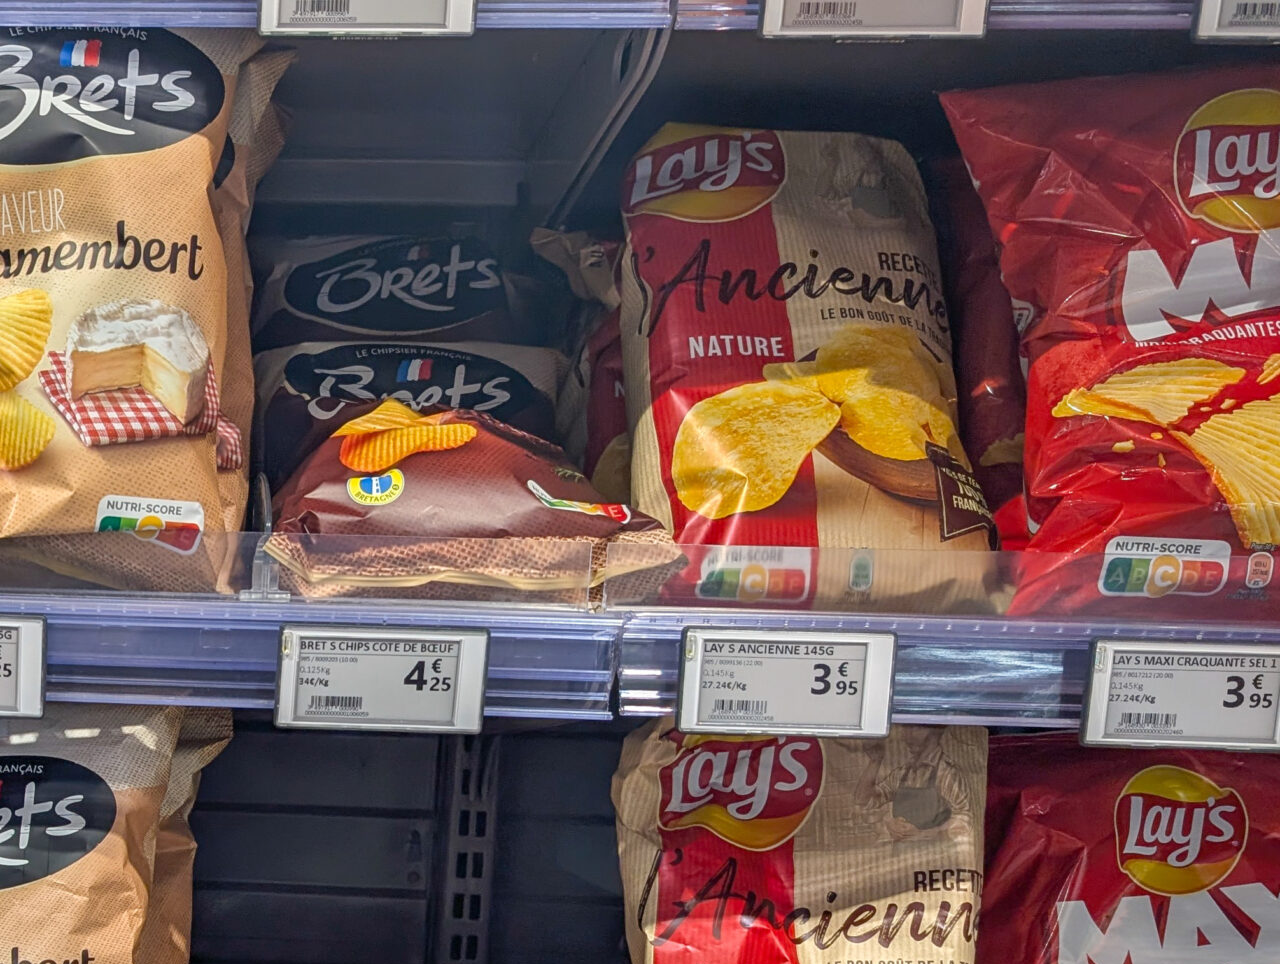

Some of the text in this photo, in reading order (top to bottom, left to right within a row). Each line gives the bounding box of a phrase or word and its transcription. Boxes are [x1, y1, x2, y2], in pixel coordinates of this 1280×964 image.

[630, 133, 774, 205] Lay's
[315, 246, 500, 313] Brets
[689, 335, 785, 358] NATURE
[106, 500, 182, 516] NUTRI-SCORE
[355, 490, 396, 503] BRETAGNE
[1115, 541, 1201, 555] NUTRI-SCORE
[301, 641, 453, 653] BRET S CHIPS COTE DE BŒUF
[704, 644, 834, 656] LAY S ANCIENNE 145G
[1113, 654, 1134, 665] LAY
[1135, 655, 1142, 665] S
[1144, 655, 1174, 666] MAXI
[1176, 656, 1245, 667] CRAQUANTE
[1248, 657, 1268, 668] SEL
[404, 660, 451, 692] 4 25
[810, 663, 858, 696] 3 95
[1222, 676, 1272, 709] 3 95
[665, 742, 809, 818] Lay's
[1123, 796, 1235, 866] Lay's
